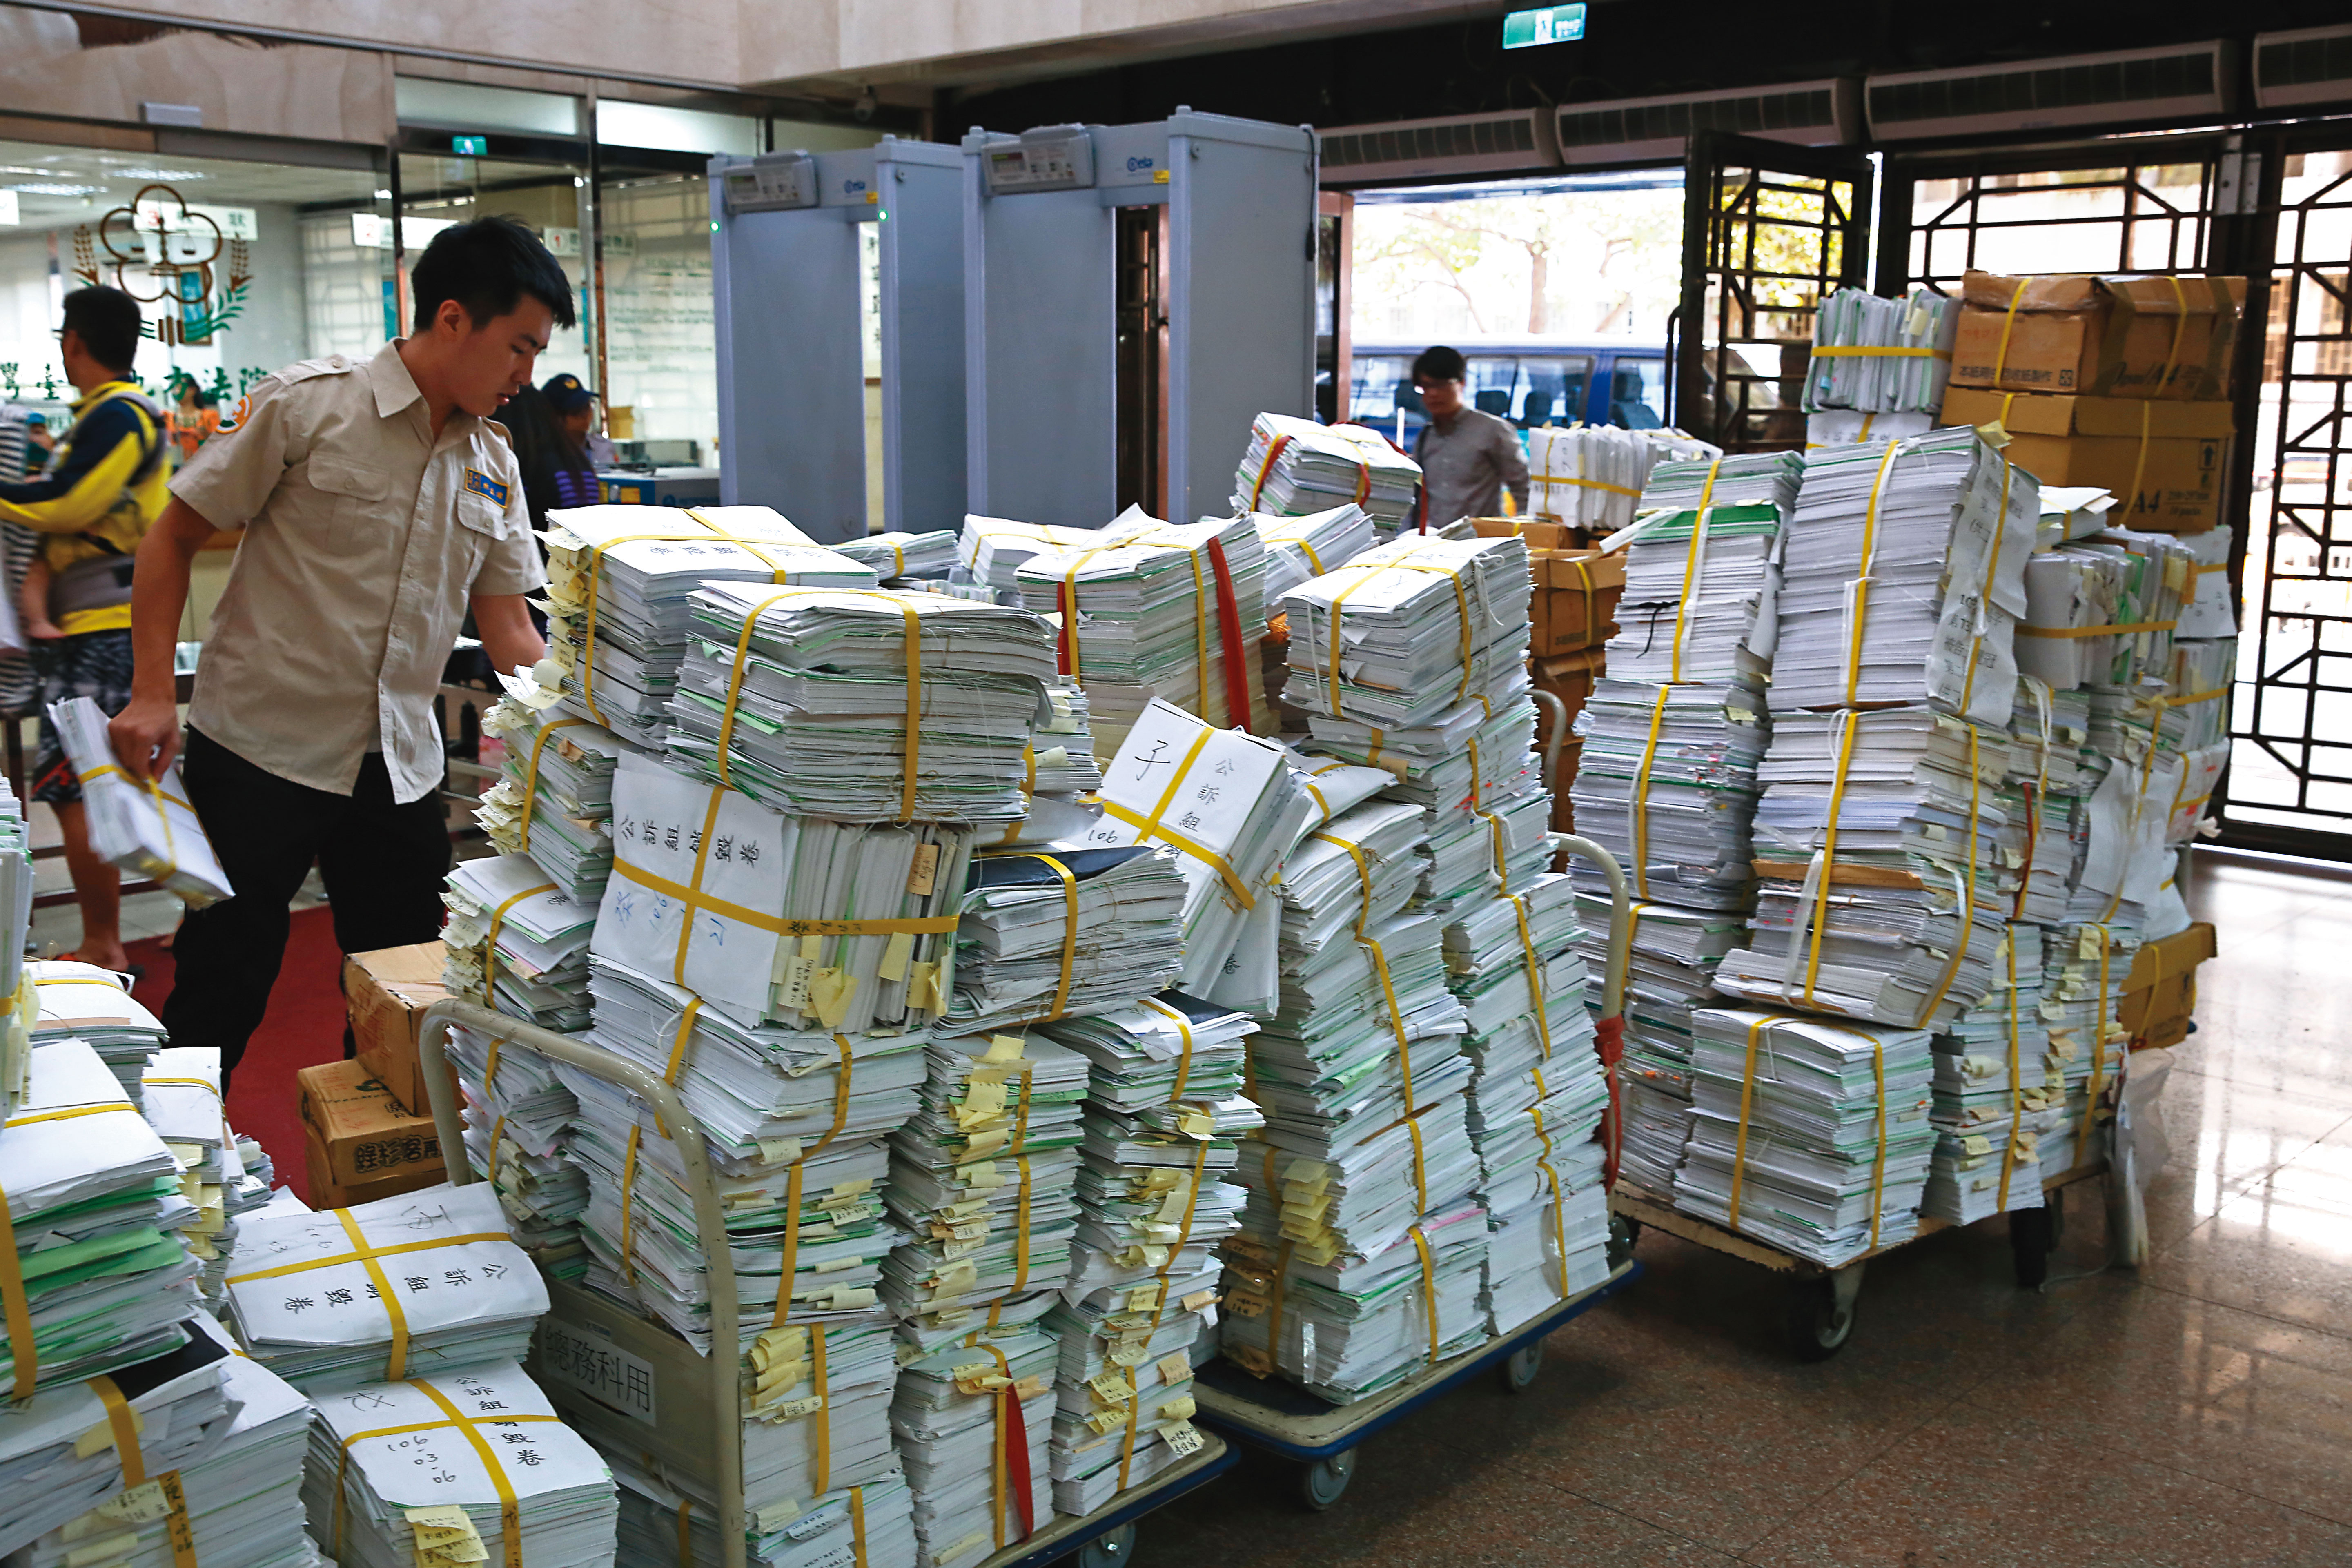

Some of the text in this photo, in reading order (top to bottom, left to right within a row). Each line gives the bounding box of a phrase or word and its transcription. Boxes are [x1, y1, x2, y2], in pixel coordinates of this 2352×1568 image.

[554, 235, 560, 247] 1
[1134, 739, 1171, 781] 子
[1088, 829, 1118, 844] 106
[388, 1435, 428, 1452] 106
[432, 1470, 457, 1484] 06
